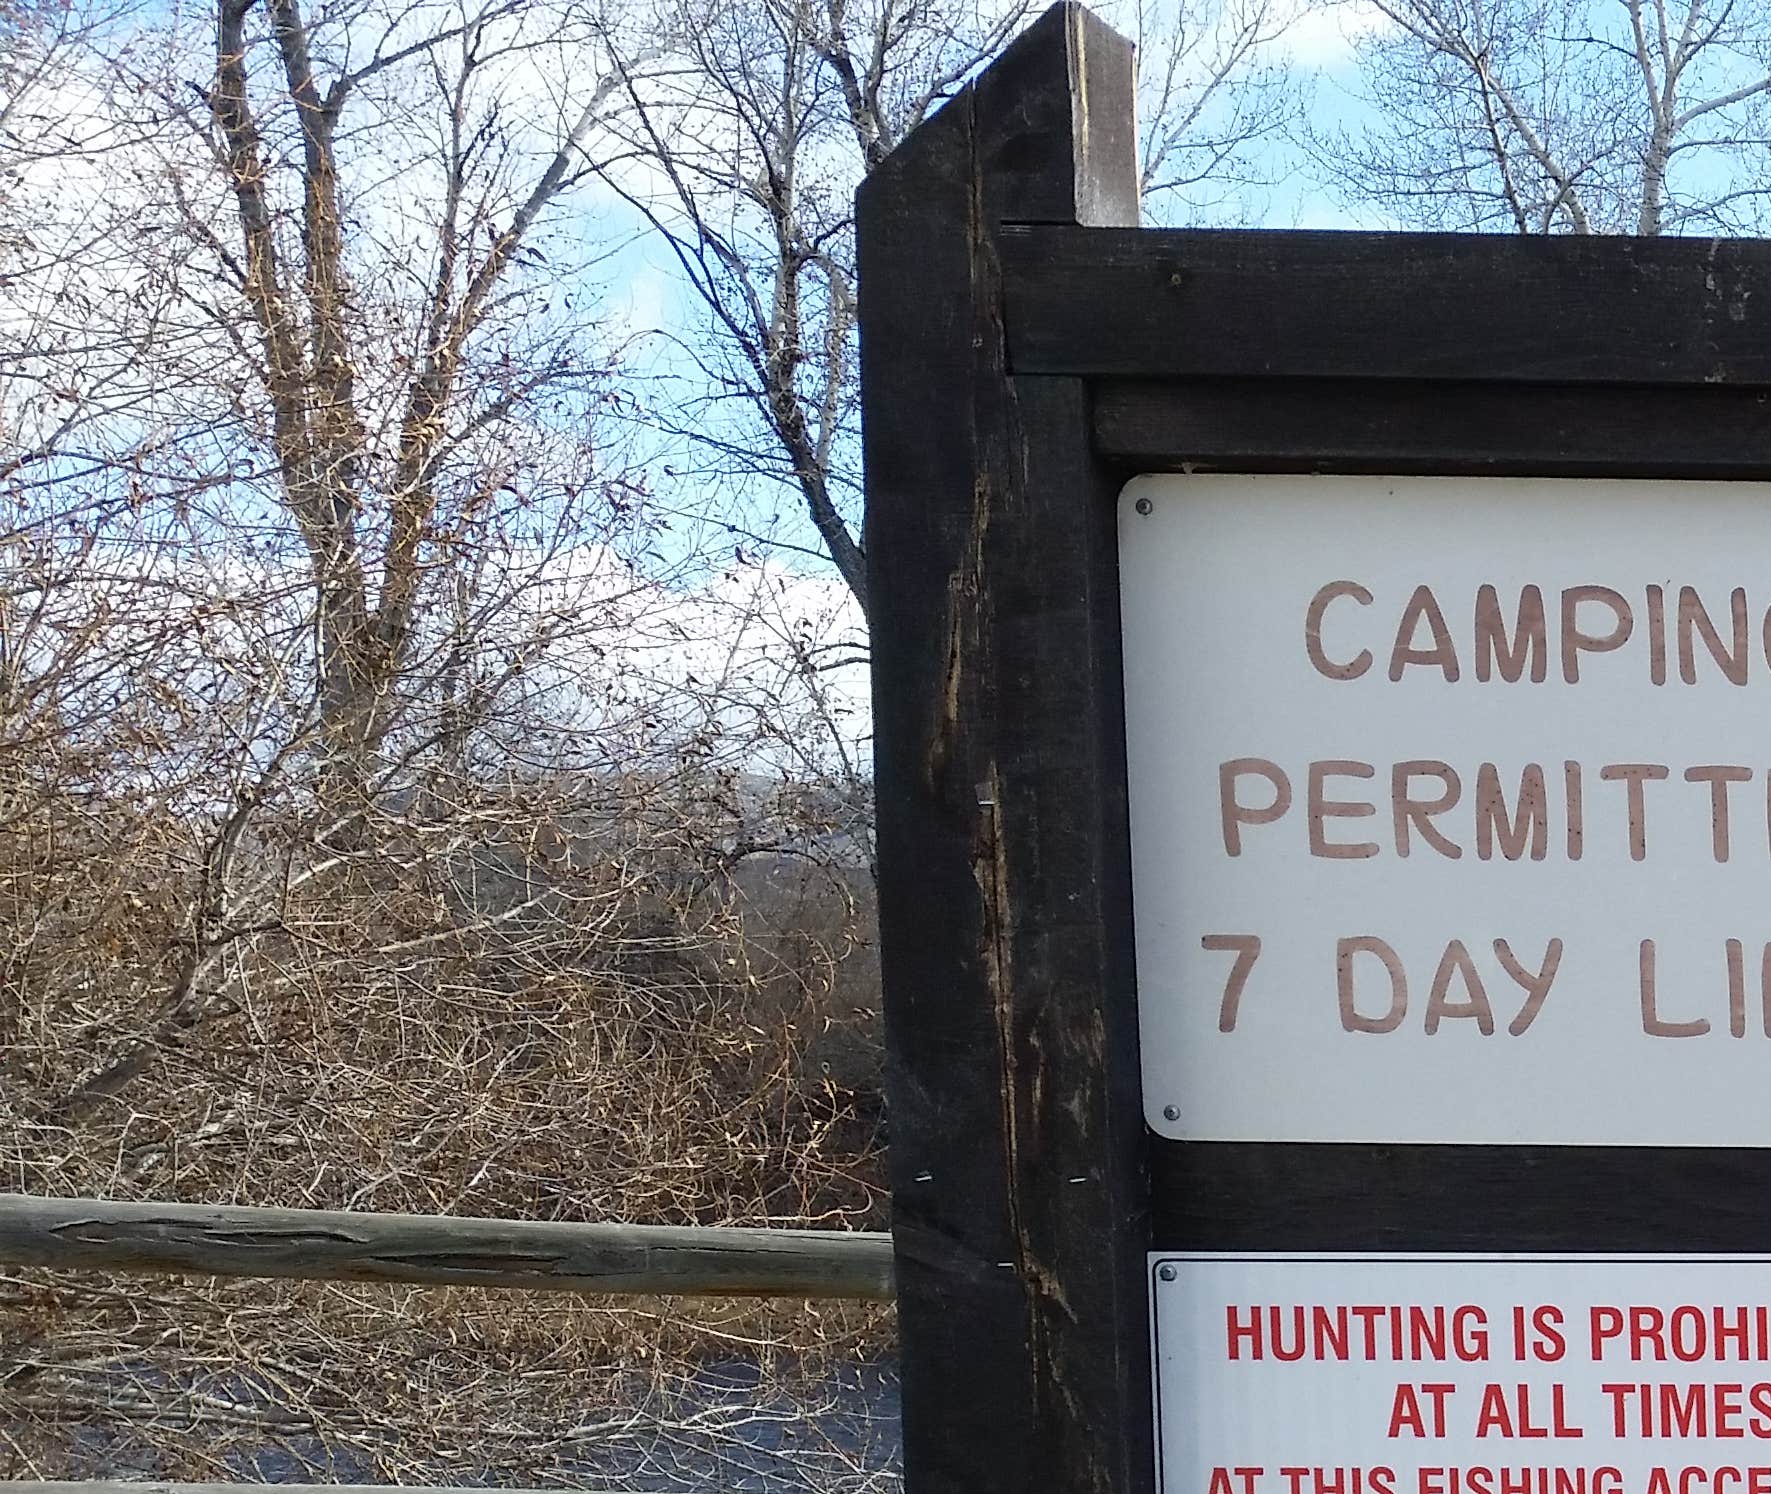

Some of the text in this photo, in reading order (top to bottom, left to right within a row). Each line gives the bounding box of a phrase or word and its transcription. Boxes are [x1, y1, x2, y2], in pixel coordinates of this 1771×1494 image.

[1200, 934, 1262, 1034] 7
[1336, 935, 1564, 1037] DAY
[1226, 1305, 1489, 1362] HUNTING
[1513, 1305, 1566, 1362] IS
[1387, 1383, 1456, 1438] AT
[1475, 1383, 1584, 1438] ALL
